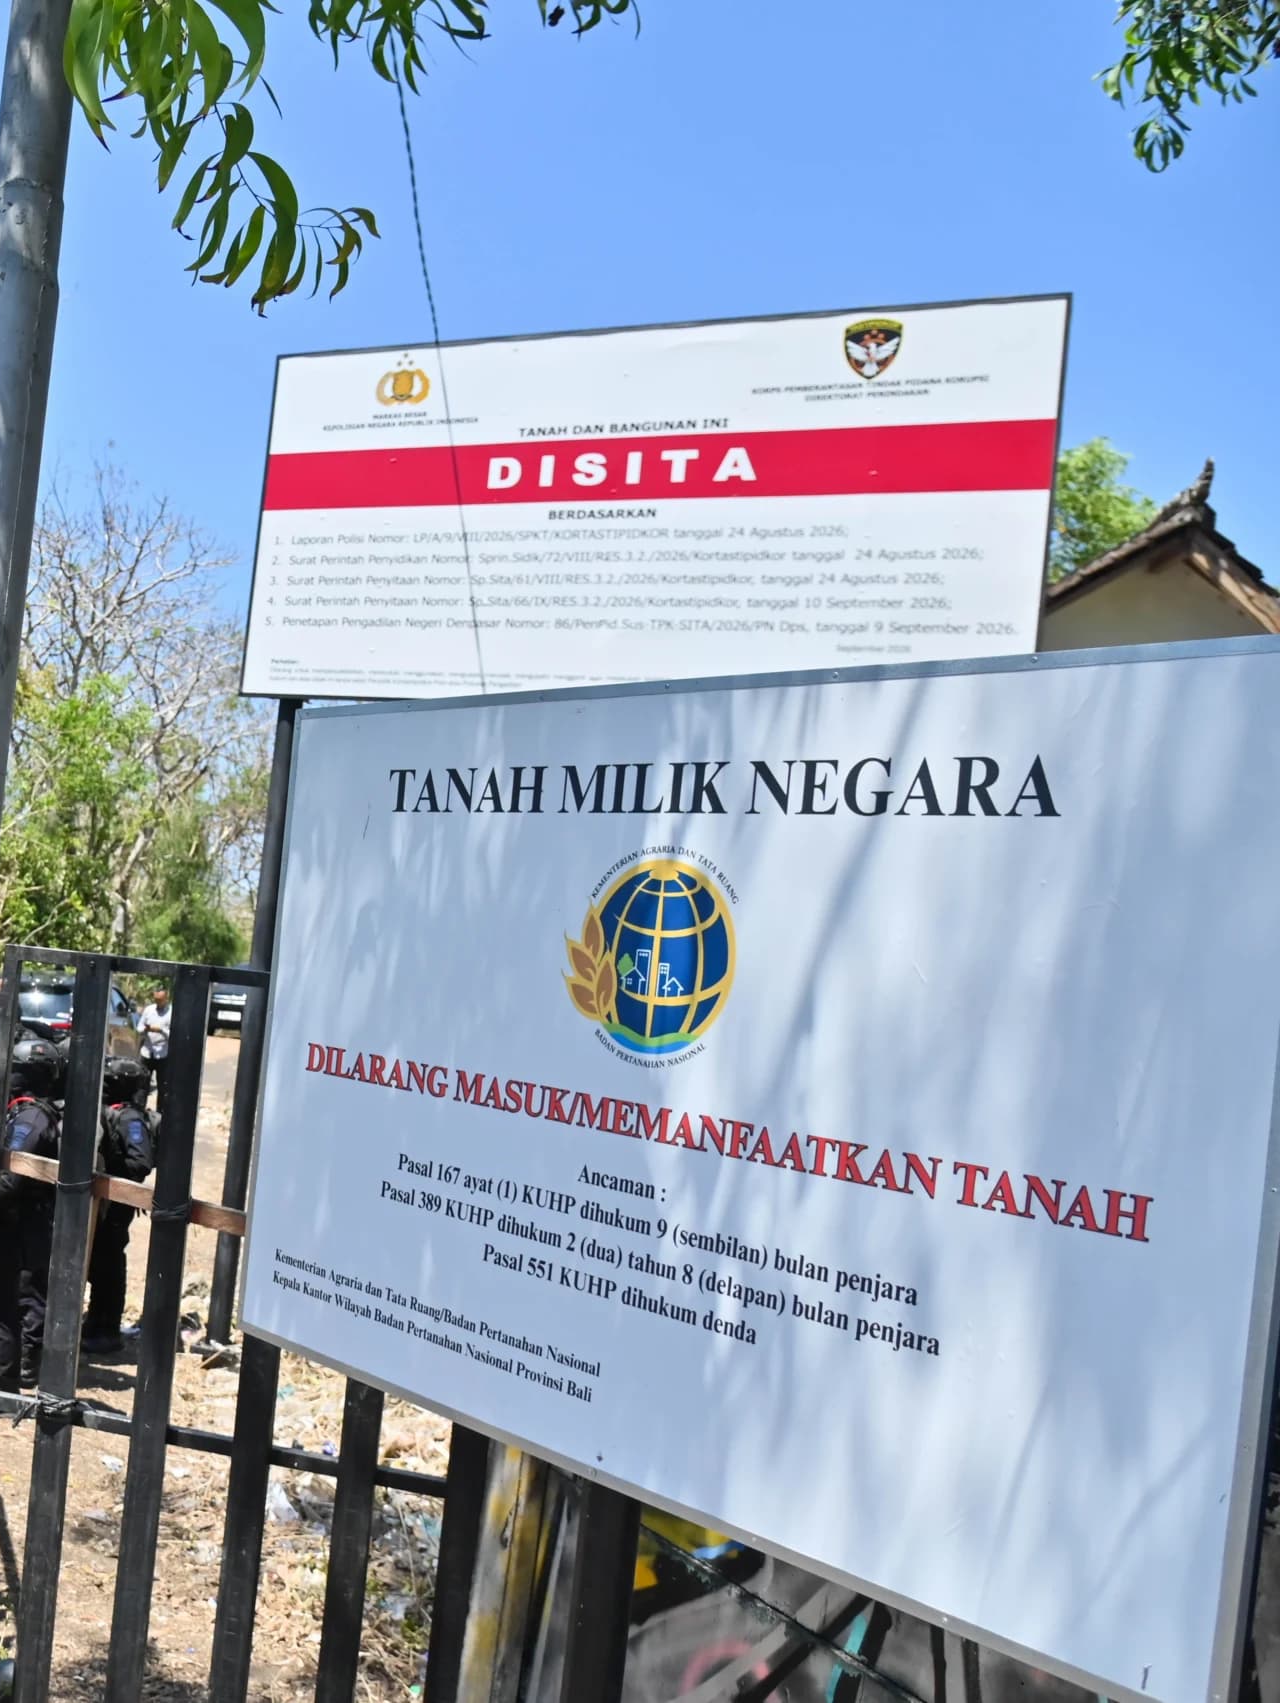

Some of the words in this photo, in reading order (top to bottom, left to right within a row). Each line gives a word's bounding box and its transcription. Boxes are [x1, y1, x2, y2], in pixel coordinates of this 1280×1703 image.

[519, 425, 569, 438] TANAH
[572, 423, 605, 435] DAN
[609, 419, 697, 434] BANGUNAN
[702, 418, 729, 429] INI
[487, 447, 757, 490] DISITA
[548, 508, 657, 520] BERDASARKAN
[291, 535, 333, 547] Laporan
[338, 534, 364, 545] Polisi
[368, 533, 409, 544] Nomor:
[674, 528, 723, 540] tanggal
[727, 527, 745, 538] 24
[749, 526, 805, 540] Agustus
[288, 555, 316, 566] Surat
[320, 554, 365, 566] Perintah
[368, 553, 428, 567] Penyidikan
[792, 550, 845, 563] tanggal
[855, 549, 873, 560] 24
[878, 548, 936, 562] Agustus
[287, 575, 315, 586] Surat
[318, 575, 362, 586] Perintah
[366, 575, 420, 588] Penyitaan
[424, 574, 466, 585] Nomor:
[761, 573, 814, 587] tanggal
[818, 573, 836, 584] 24
[840, 573, 898, 586] Agustus
[284, 595, 312, 607] Surat
[316, 595, 361, 607] Perintah
[364, 595, 418, 609] Penyitaan
[422, 595, 464, 607] Nomor:
[747, 597, 800, 611] tanggal
[804, 597, 821, 608] 10
[825, 596, 904, 610] September
[282, 616, 338, 628] Penetapan
[342, 617, 402, 630] Pengadilan
[405, 618, 442, 630] Negeri
[505, 618, 548, 629] Nomor:
[816, 621, 869, 635] tanggal
[874, 621, 884, 633] 9
[888, 621, 969, 636] September
[389, 766, 548, 814] TANAH
[557, 762, 729, 815] MILIK
[744, 754, 1062, 818] NEGARA
[591, 849, 640, 899] KEMENTERIAN
[640, 844, 676, 857] AGRARIA
[677, 846, 697, 860] DAN
[697, 854, 718, 875] TATA
[716, 871, 740, 905] RUANG
[594, 1028, 616, 1055] BADAN
[666, 1043, 707, 1068] NASIONAL
[305, 1042, 449, 1099] DILARANG
[453, 1069, 943, 1200] MASUK/MEMANFAATKAN
[953, 1160, 1155, 1243] TANAH
[576, 1164, 656, 1201] Ancaman
[398, 1153, 433, 1179] Pasal
[437, 1163, 461, 1185] 167
[463, 1172, 493, 1198] ayat
[496, 1177, 519, 1205] (1)
[522, 1184, 577, 1217] KUHP
[580, 1200, 651, 1236] dihukum
[656, 1218, 668, 1240] 9
[672, 1223, 769, 1270] (sembilan)
[774, 1249, 829, 1283] bulan
[834, 1268, 918, 1307] penjara
[380, 1181, 415, 1207] Pasal
[418, 1191, 442, 1214] 389
[445, 1197, 494, 1229] KUHP
[497, 1212, 563, 1248] dihukum
[566, 1231, 576, 1253] 2
[580, 1235, 623, 1269] (dua)
[628, 1250, 677, 1281] tahun
[681, 1264, 694, 1286] 8
[698, 1268, 786, 1316] (delapan)
[792, 1295, 849, 1331] bulan
[855, 1316, 940, 1357] penjara
[275, 1248, 326, 1279] Kementerian
[329, 1269, 363, 1294] Agraria
[365, 1281, 383, 1299] dan
[385, 1288, 408, 1308] Tata
[410, 1296, 477, 1335] Ruang/Badan
[479, 1318, 543, 1358] Pertanahan
[546, 1343, 601, 1378] Nasional
[483, 1243, 523, 1274] Pasal
[527, 1256, 554, 1283] 551
[560, 1267, 618, 1300] KUHP
[621, 1287, 697, 1327] dihukum
[703, 1306, 757, 1345] denda
[272, 1270, 301, 1292] Kepala
[303, 1281, 332, 1304] Kantor
[334, 1293, 372, 1321] Wilayah
[374, 1308, 405, 1332] Badan
[407, 1320, 462, 1355] Pertanahan
[464, 1342, 513, 1374] Nasional
[516, 1361, 564, 1393] Provinsi
[566, 1380, 593, 1403] Bali
